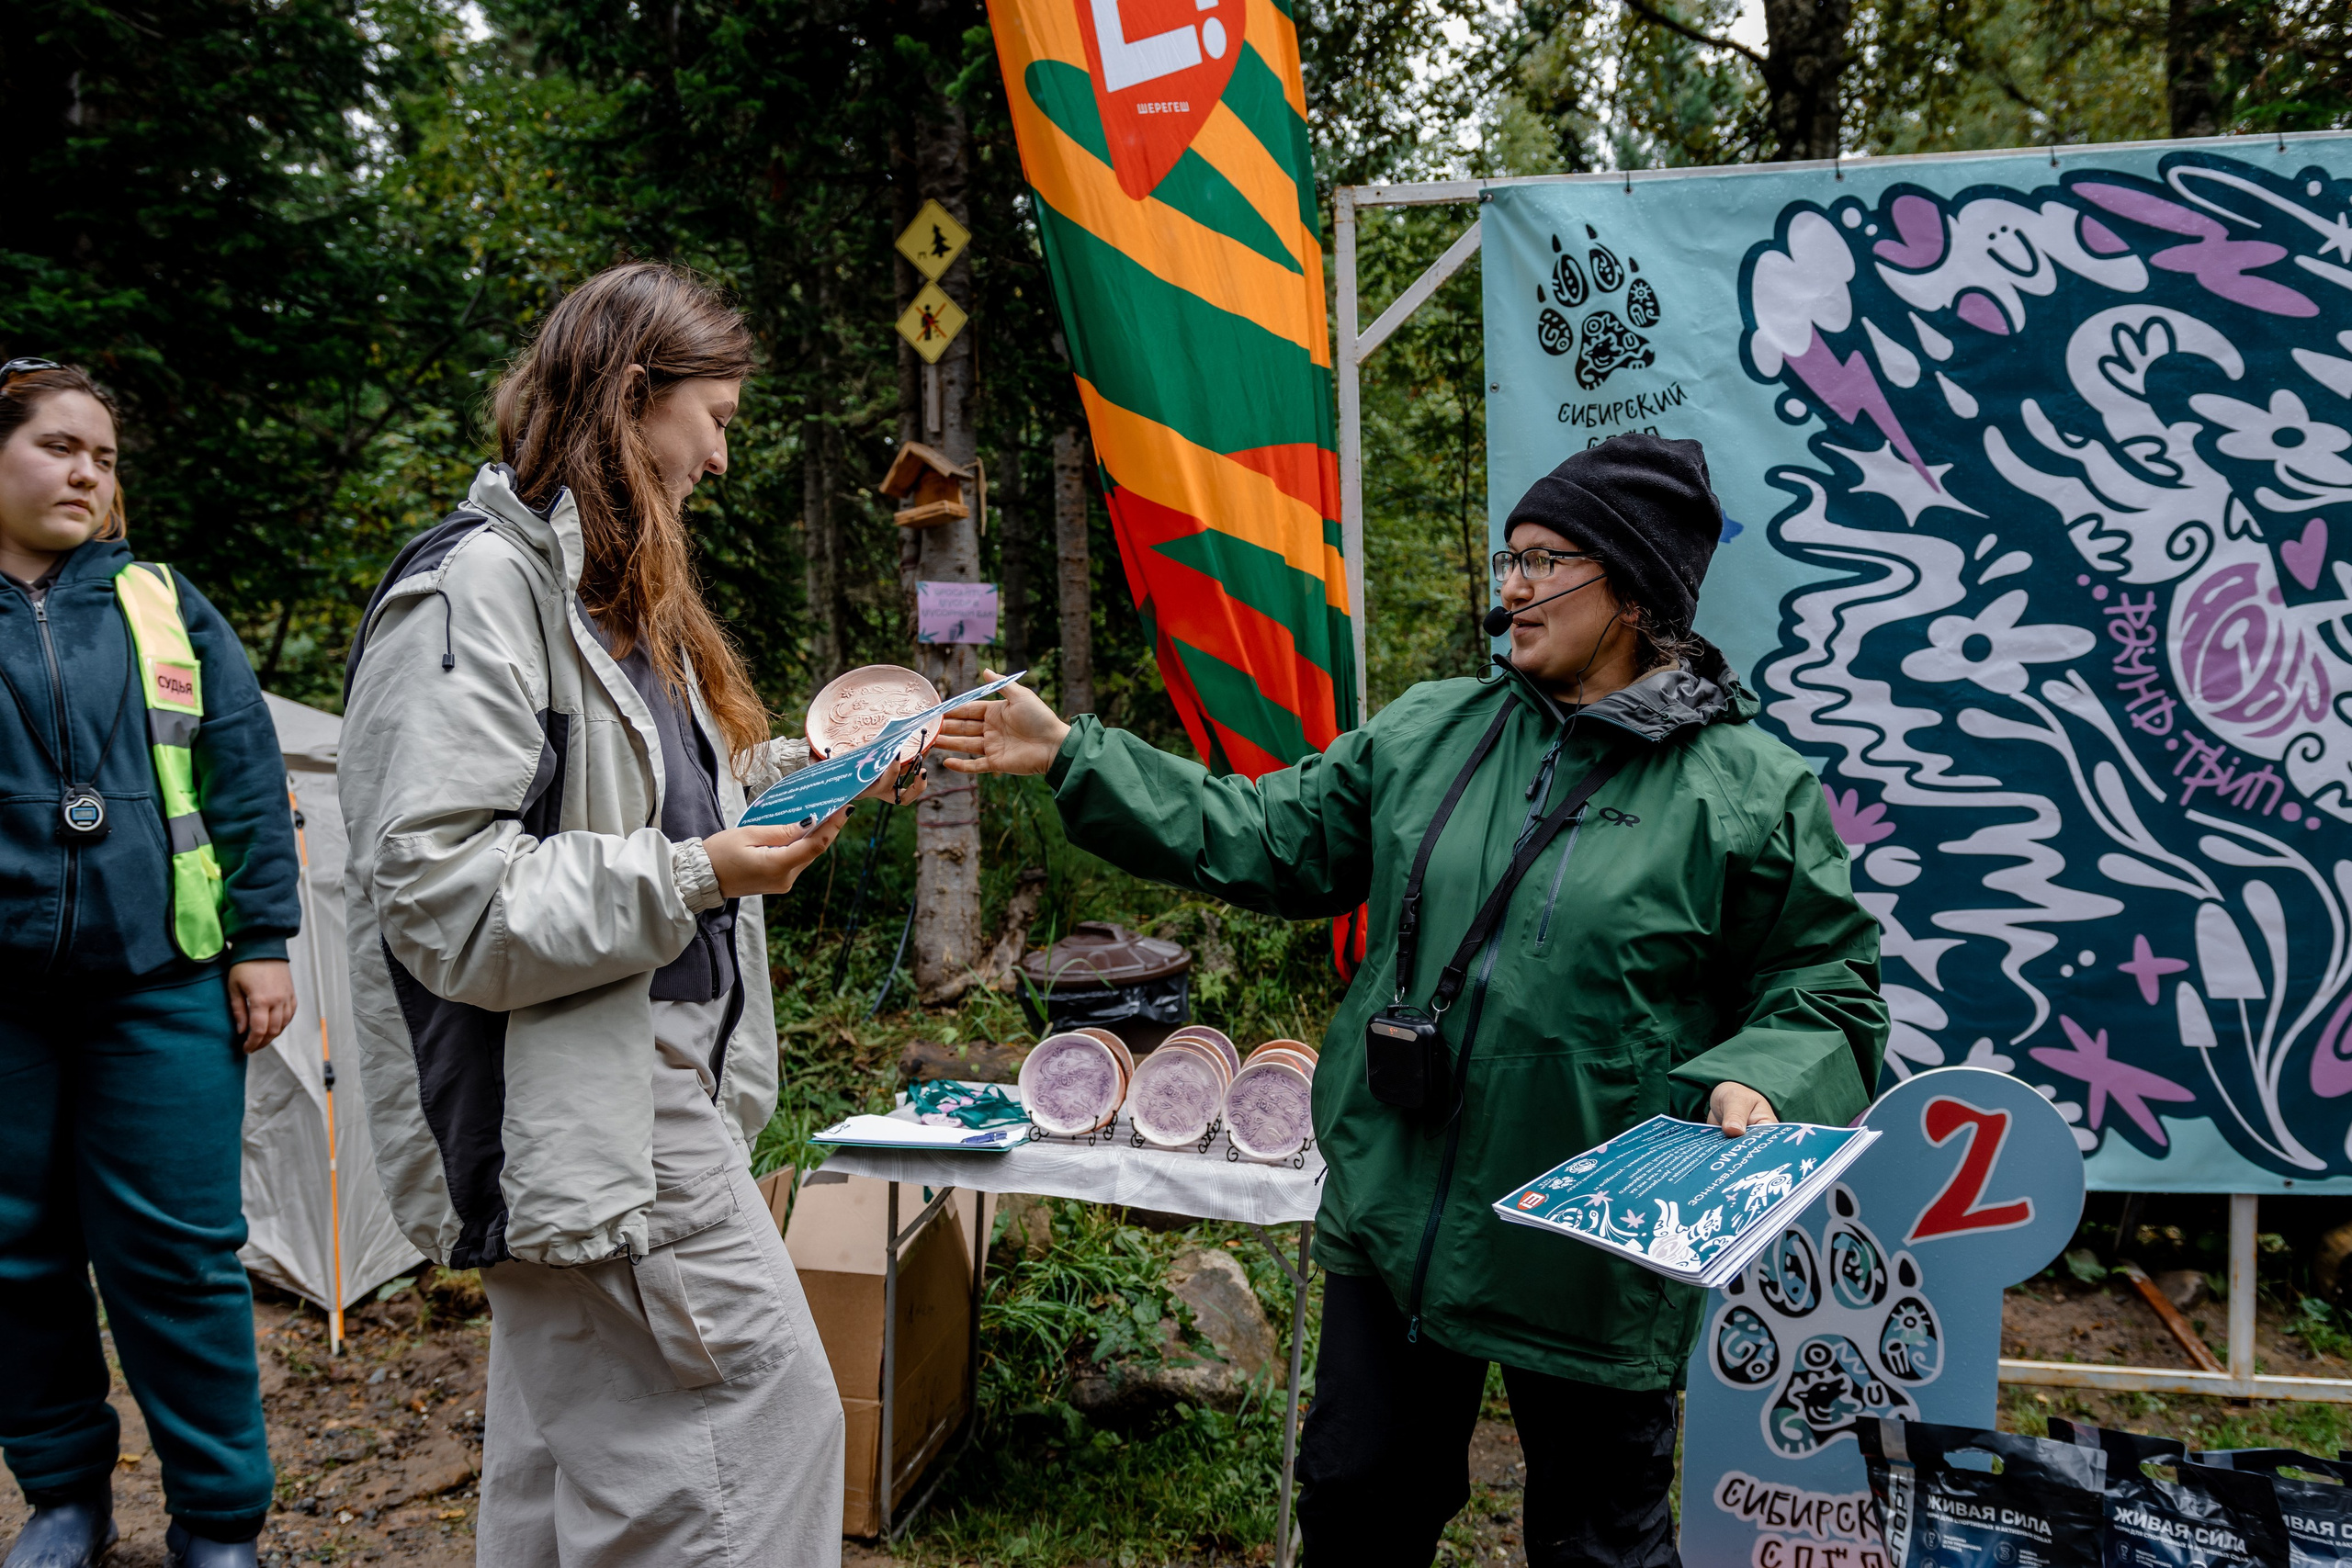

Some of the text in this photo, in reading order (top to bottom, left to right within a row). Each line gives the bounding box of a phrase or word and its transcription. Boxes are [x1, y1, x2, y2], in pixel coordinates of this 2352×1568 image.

[1136, 101, 1190, 115] ШЕРЕГЕШ
[1558, 381, 1688, 427] СИБИРСКИЙ
[158, 675, 193, 695] СУДЬЯ
[1599, 807, 1641, 828] OR
[1688, 1127, 1792, 1206] БЛАГОДАРСТВЕННОЕ
[1710, 1126, 1780, 1171] ПИСЬМО
[1907, 1098, 2032, 1241] 2
[1890, 1473, 1909, 1568] СПОРТ
[1927, 1495, 2052, 1536] ЖИВАЯ СИЛА
[2113, 1506, 2248, 1555] ЖИВАЯ СИЛА
